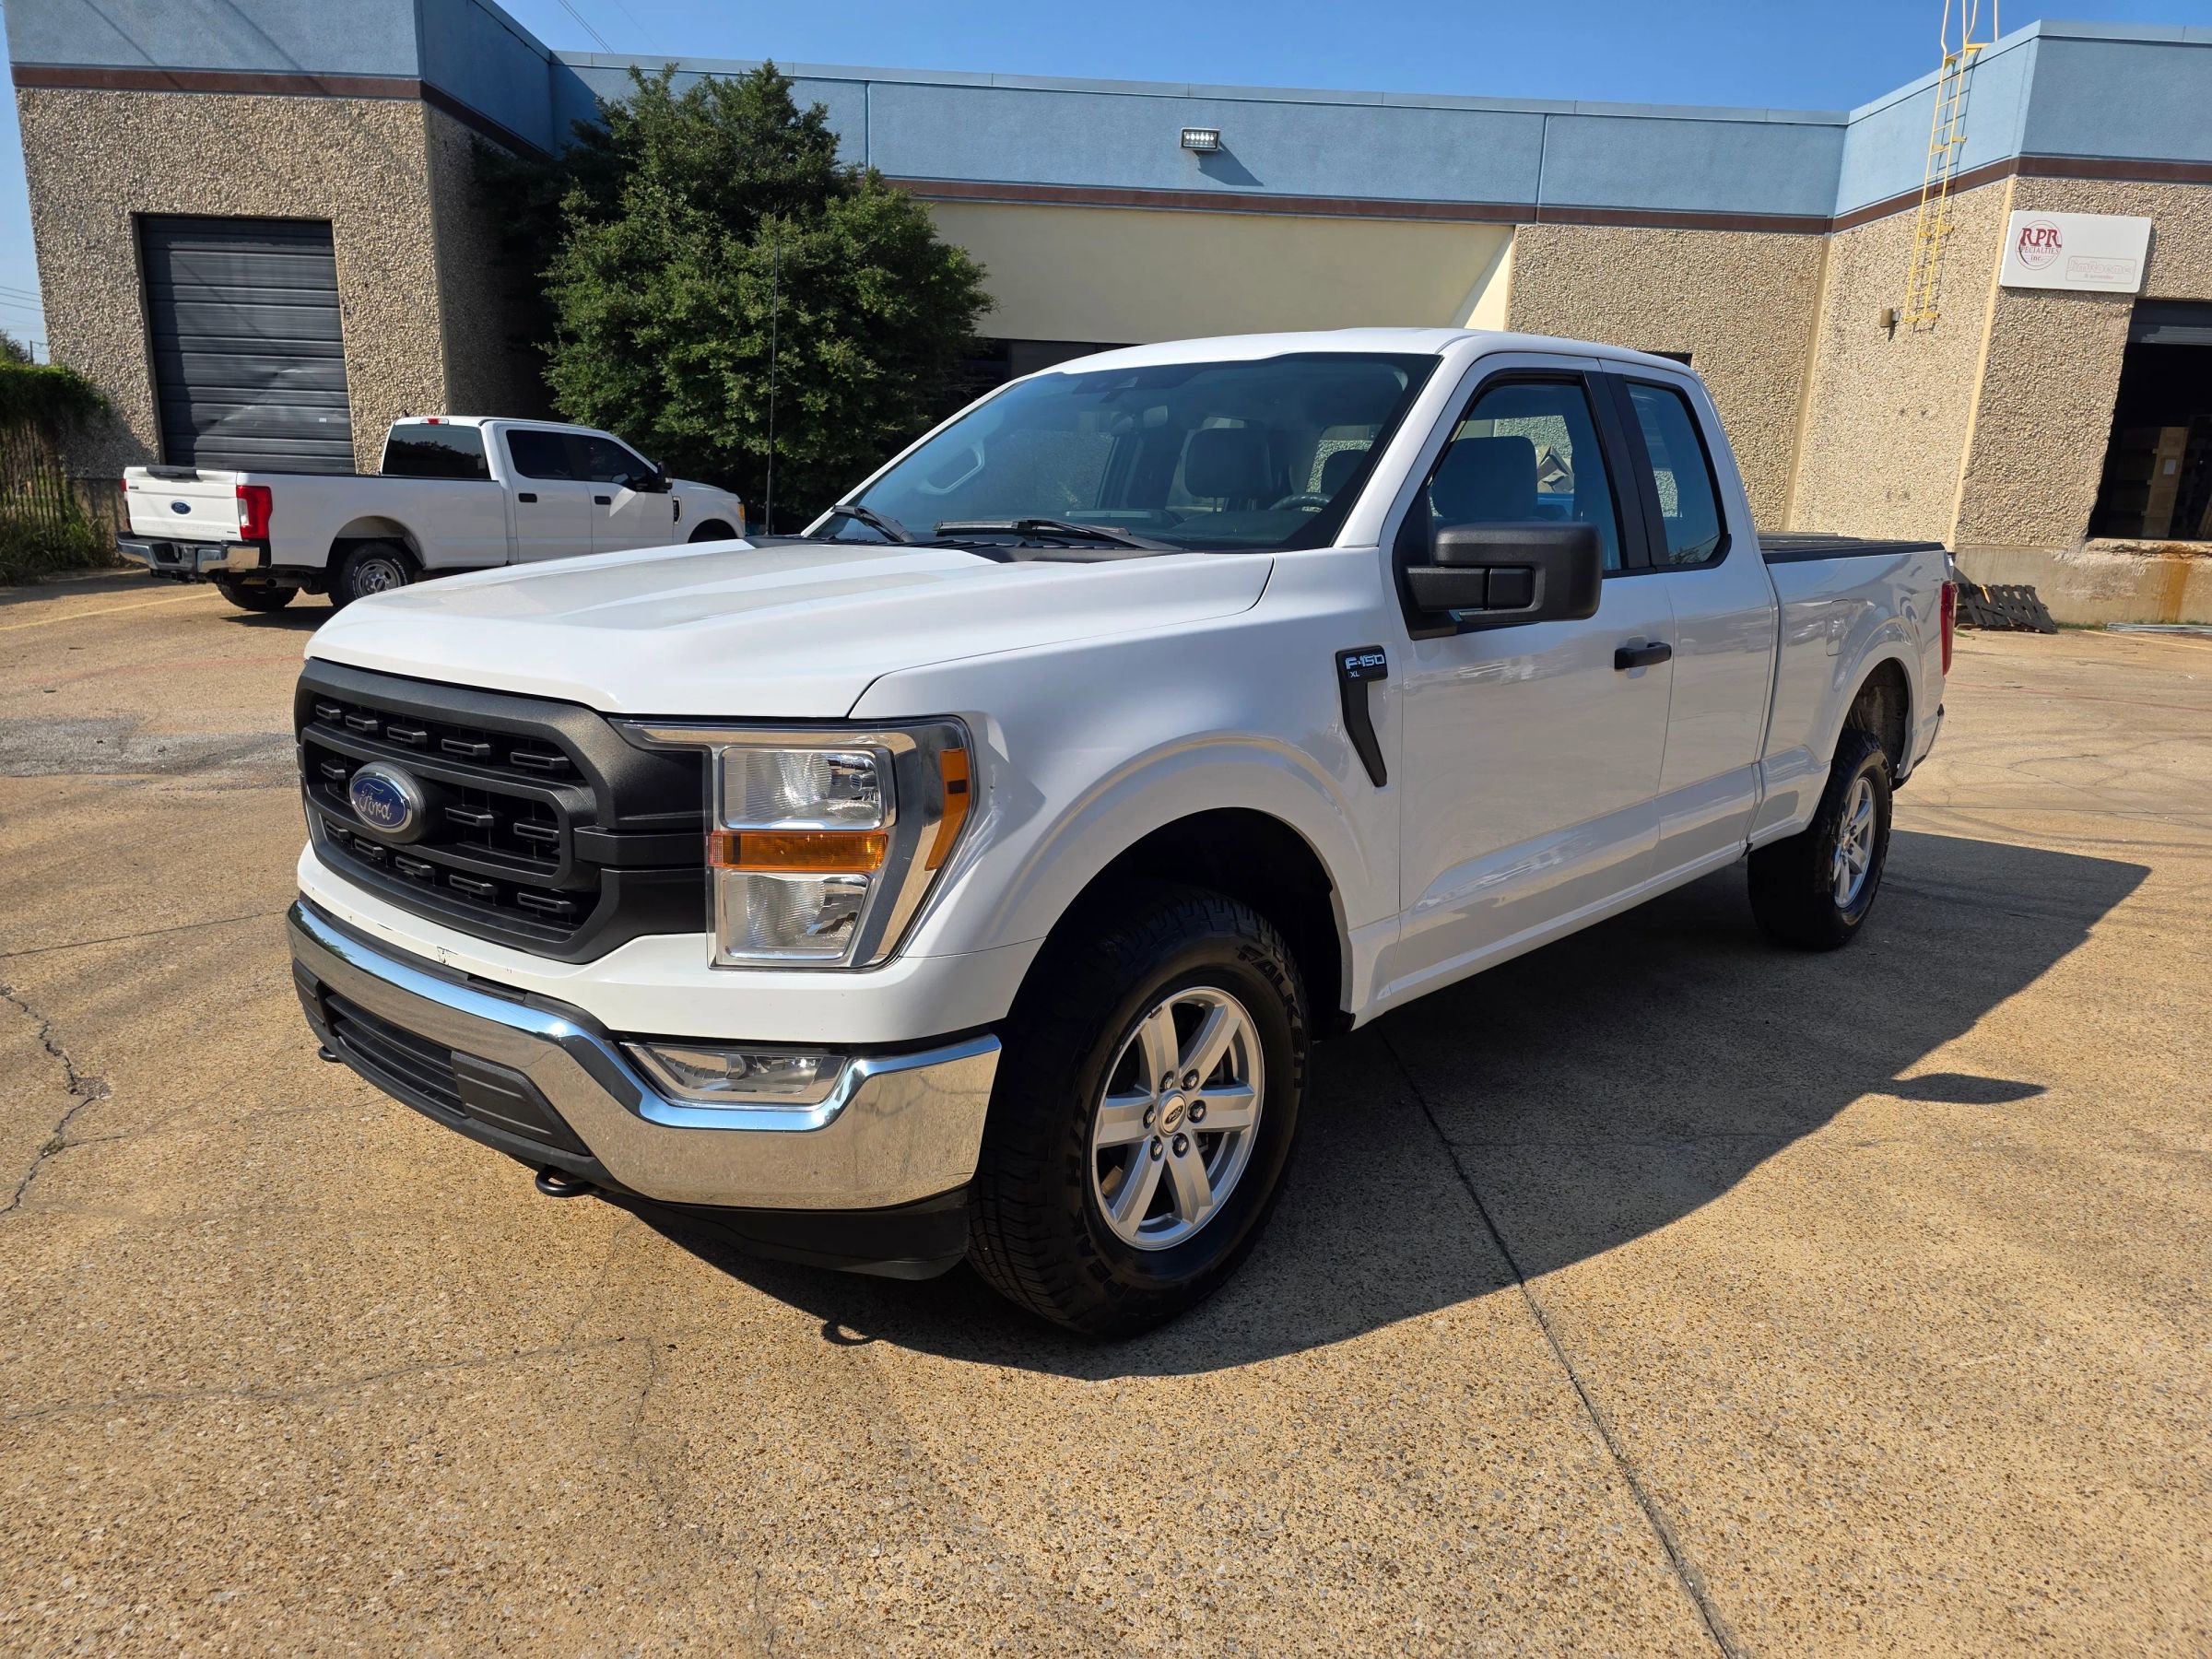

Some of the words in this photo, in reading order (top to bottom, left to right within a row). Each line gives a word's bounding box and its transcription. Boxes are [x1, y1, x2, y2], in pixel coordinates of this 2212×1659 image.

[2019, 228, 2062, 248] RPR
[1346, 654, 1384, 670] F-150
[359, 782, 393, 820] Ford
[1236, 944, 1305, 1088] FALKEN
